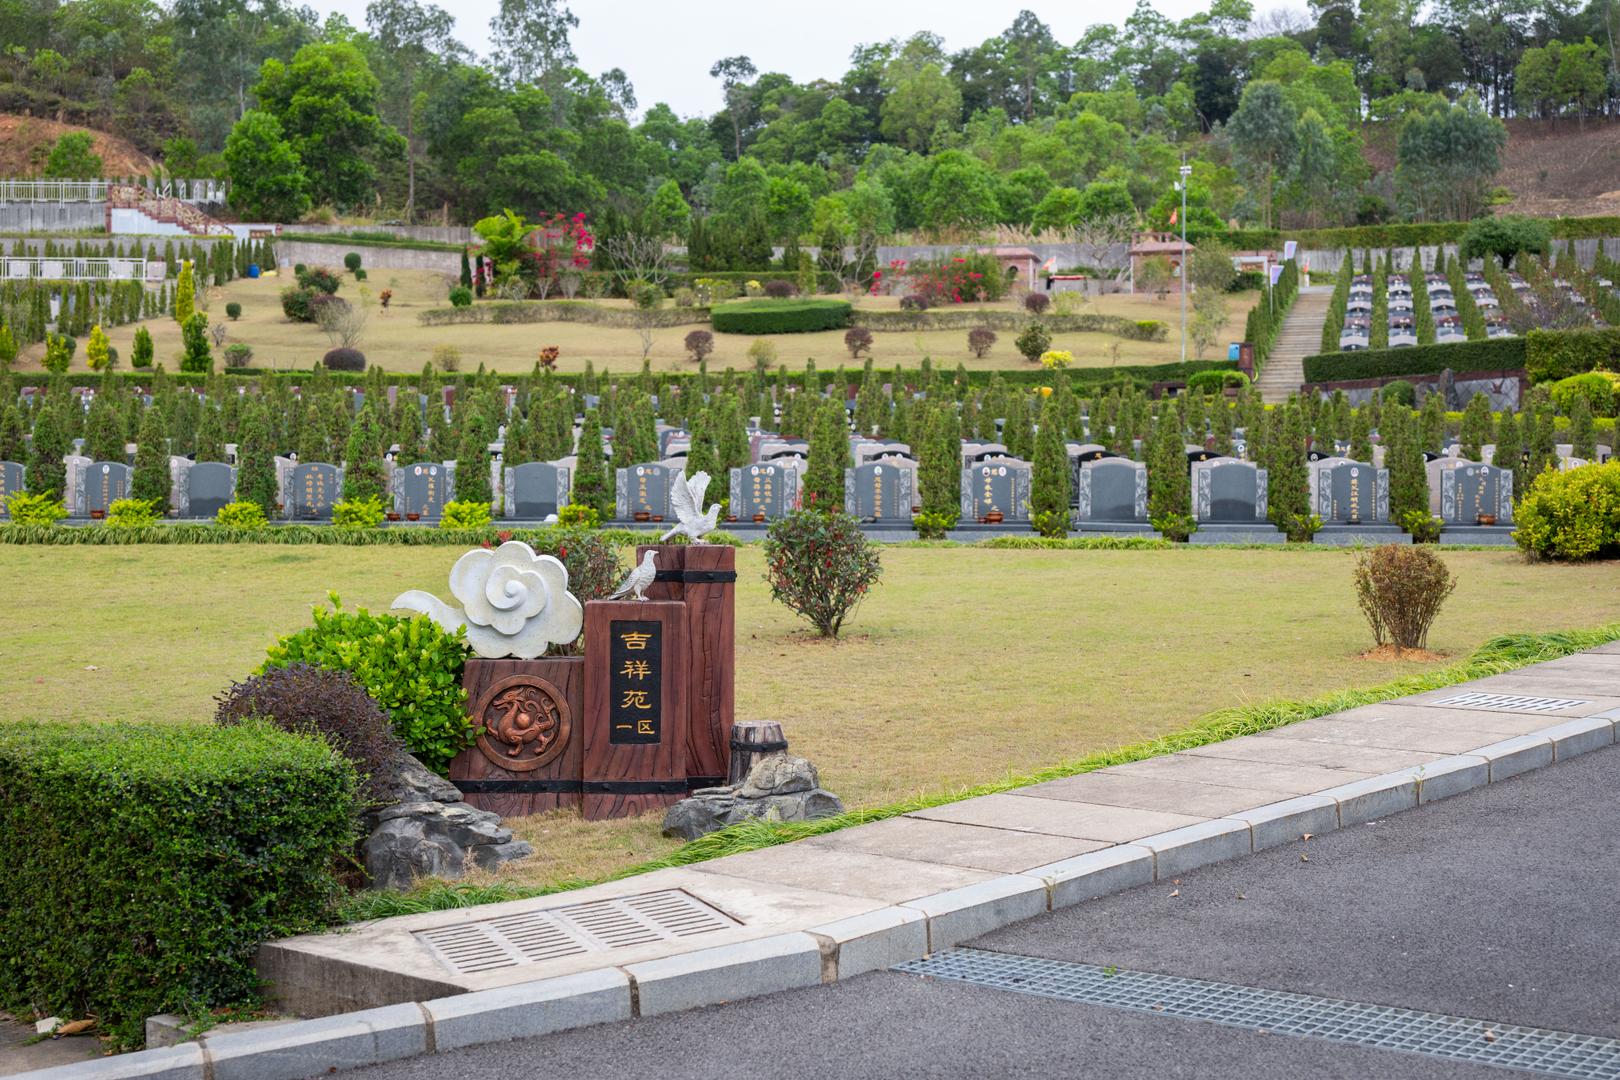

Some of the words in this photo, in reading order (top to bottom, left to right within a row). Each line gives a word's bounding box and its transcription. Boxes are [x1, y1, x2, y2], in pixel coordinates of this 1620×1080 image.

[620, 631, 652, 709] 吉祥苑
[616, 720, 655, 734] 一区
